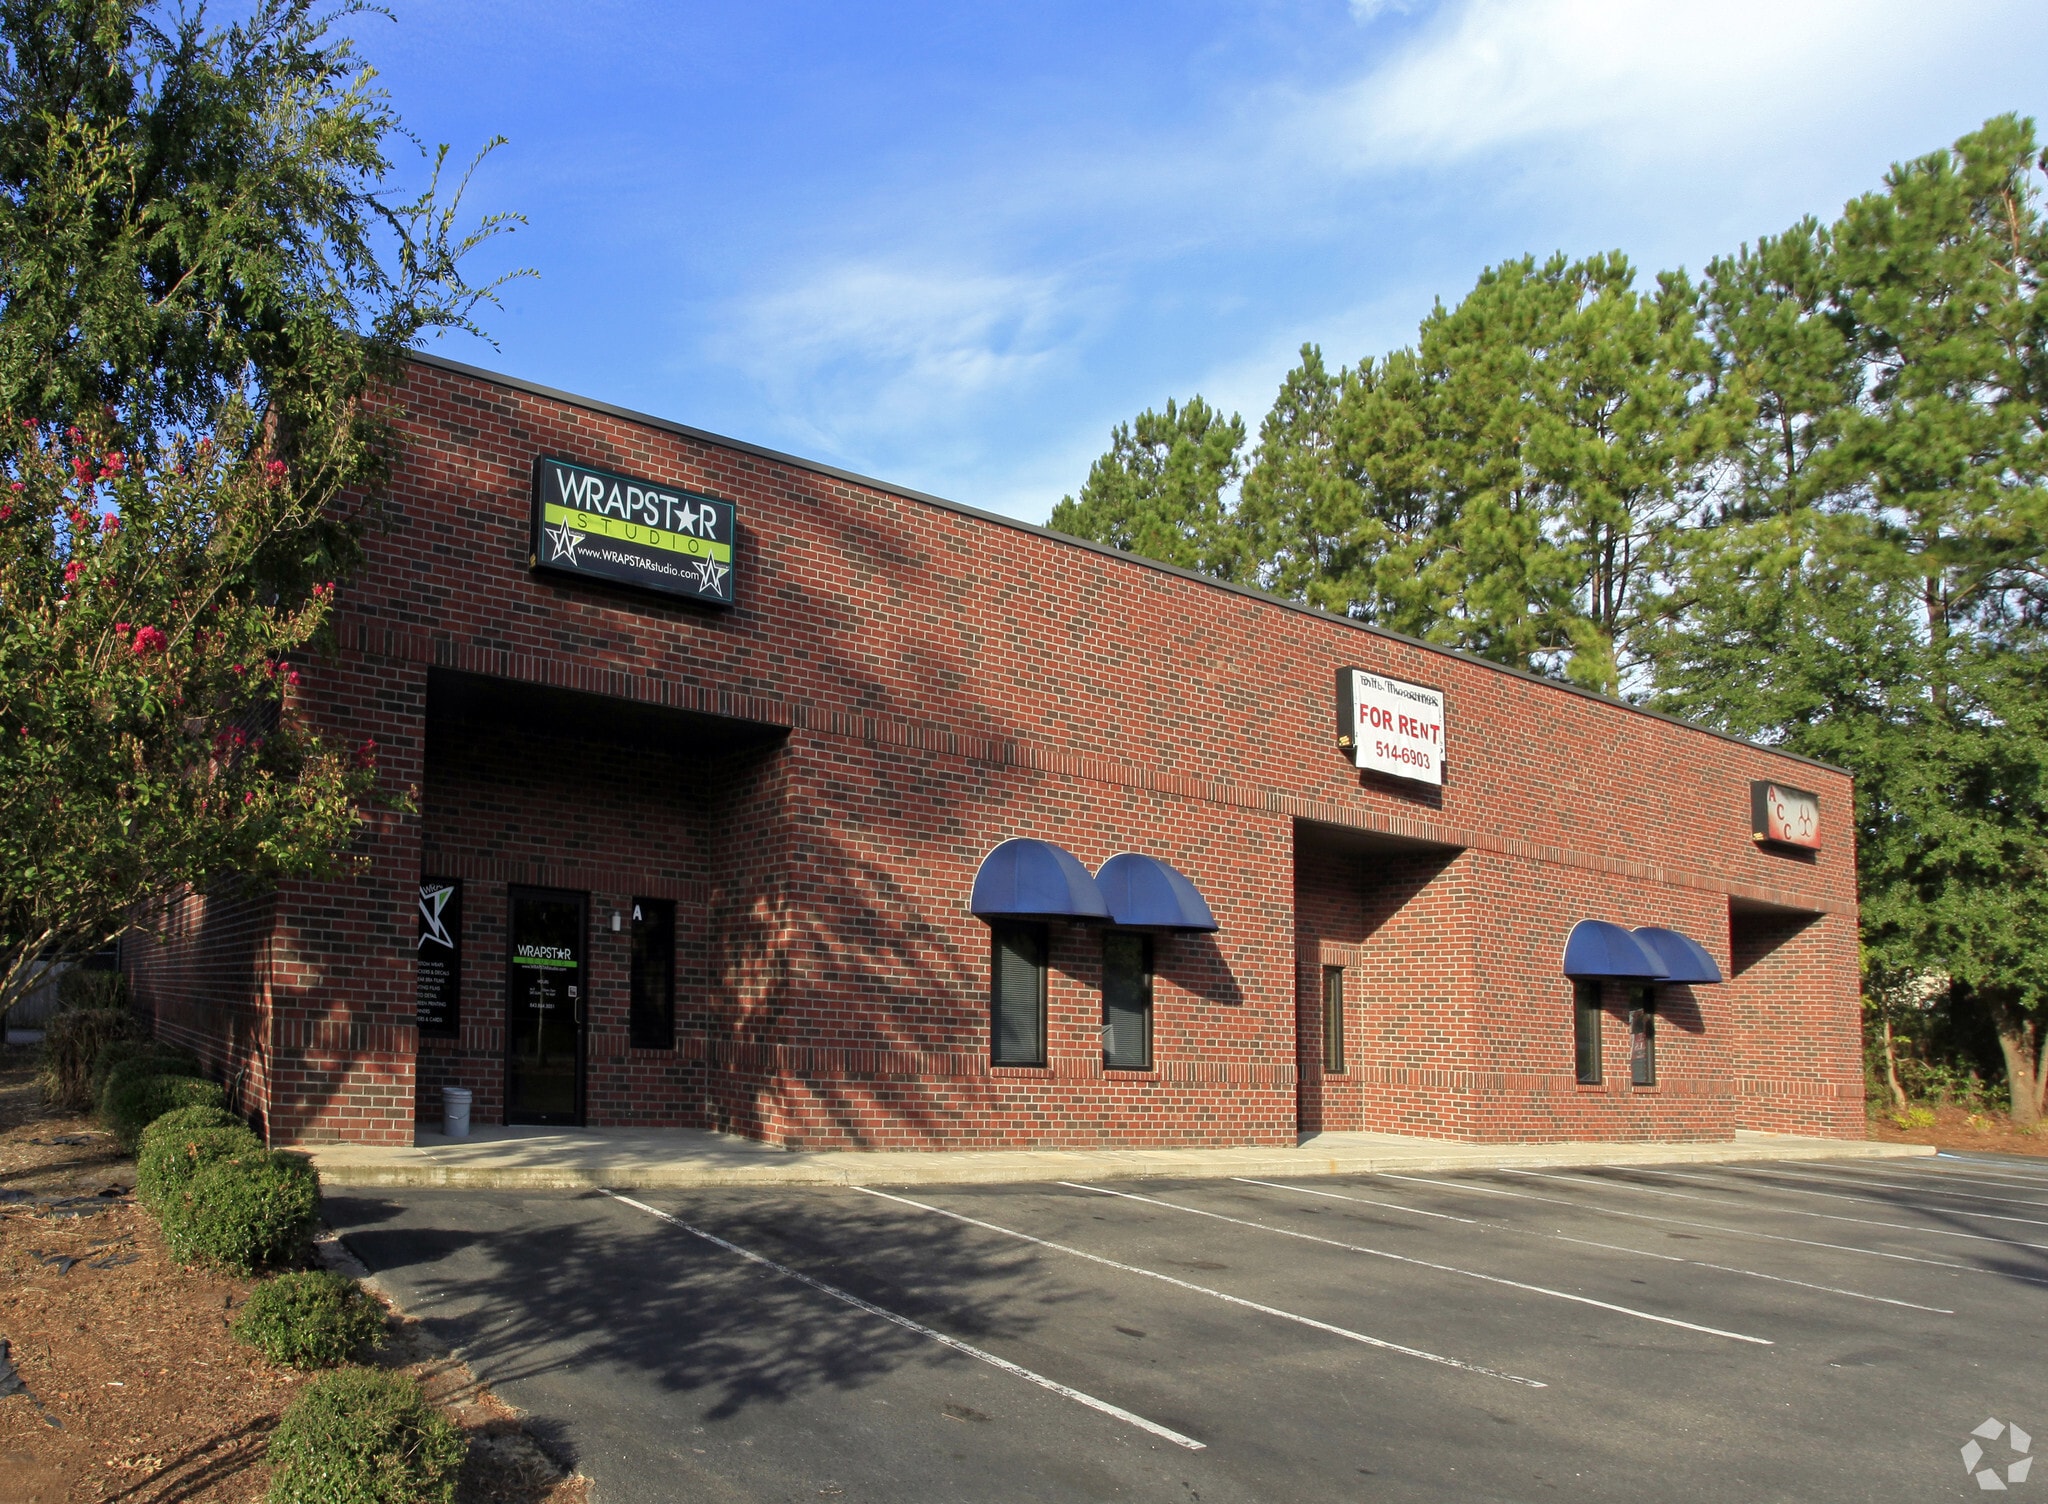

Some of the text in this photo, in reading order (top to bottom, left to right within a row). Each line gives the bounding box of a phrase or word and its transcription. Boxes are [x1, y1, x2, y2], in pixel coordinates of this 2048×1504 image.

[577, 512, 700, 554] STUDIO
[577, 546, 700, 581] www.WRAPSTARstudio.com
[1359, 703, 1440, 745] FOR RENT
[1376, 740, 1430, 770] 514-6903
[632, 904, 642, 921] A
